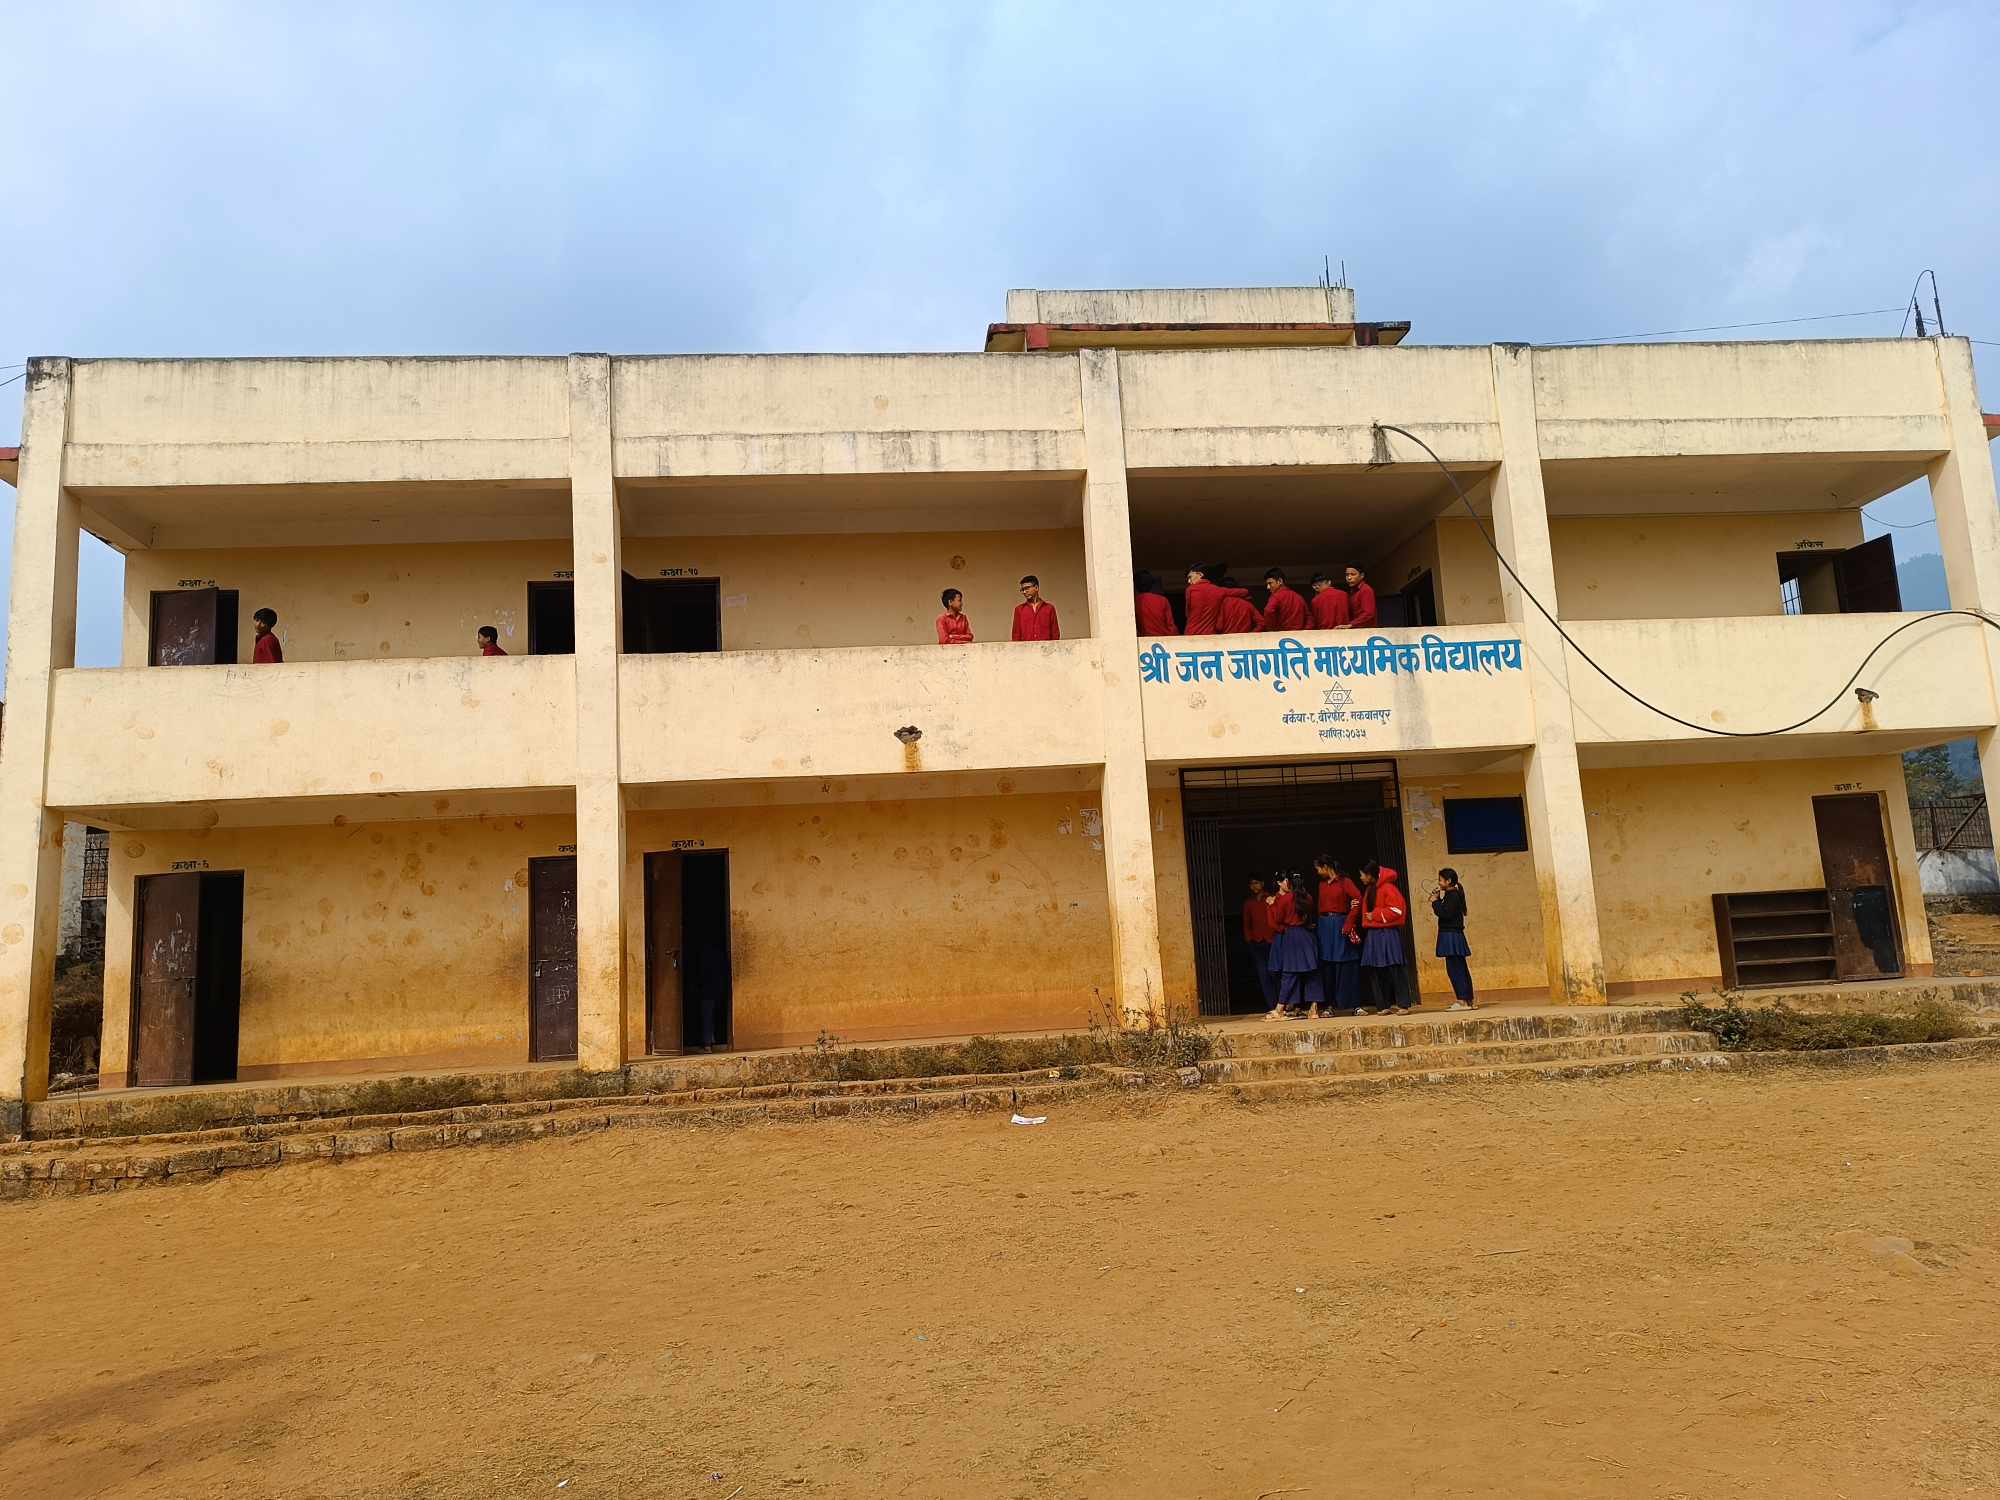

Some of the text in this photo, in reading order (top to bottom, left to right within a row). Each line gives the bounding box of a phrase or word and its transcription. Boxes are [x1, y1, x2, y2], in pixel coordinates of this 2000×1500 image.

[1138, 634, 1523, 694] श्री जन जागृति माध्यमिक विद्यालय
